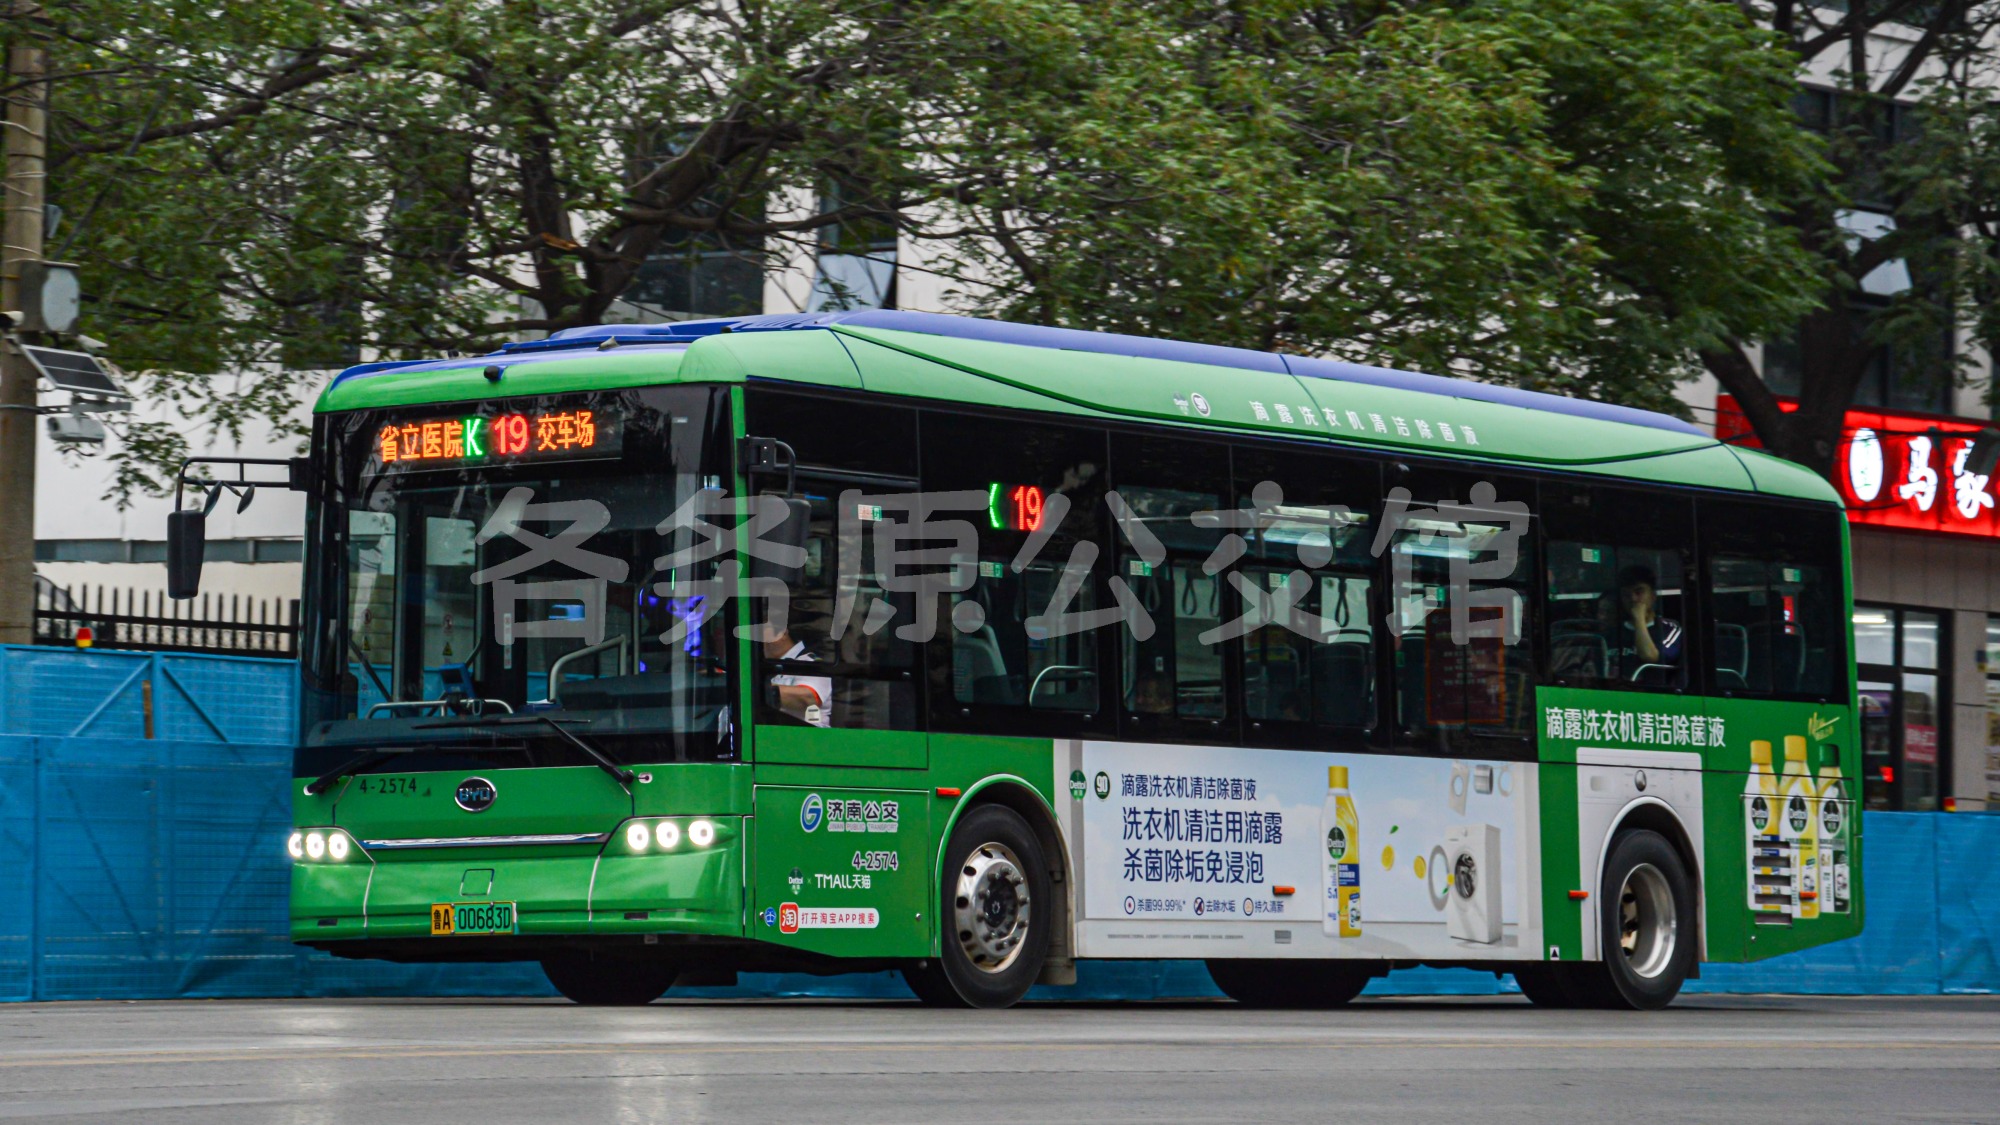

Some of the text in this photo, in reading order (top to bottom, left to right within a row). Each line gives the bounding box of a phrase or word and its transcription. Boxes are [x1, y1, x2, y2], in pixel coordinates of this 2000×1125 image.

[494, 415, 528, 453] 19
[537, 411, 595, 451] 交车场
[1014, 485, 1042, 531] 19
[1545, 706, 1726, 748] 滴露洗衣机清洁除菌液
[359, 778, 417, 794] 4-2574
[458, 786, 491, 802] BYD
[1121, 773, 1257, 801] 滴露洗衣机清洁除菌液
[827, 800, 898, 821] 济南公交
[1122, 806, 1283, 845] 洗衣机清洁用滴露
[853, 851, 898, 870] 4-2574
[1123, 848, 1265, 884] 杀菌除垢免浸泡
[1206, 900, 1236, 913] 去除水垢
[781, 908, 797, 928] 淘
[801, 912, 876, 925] 打开淘宝APP搜索
